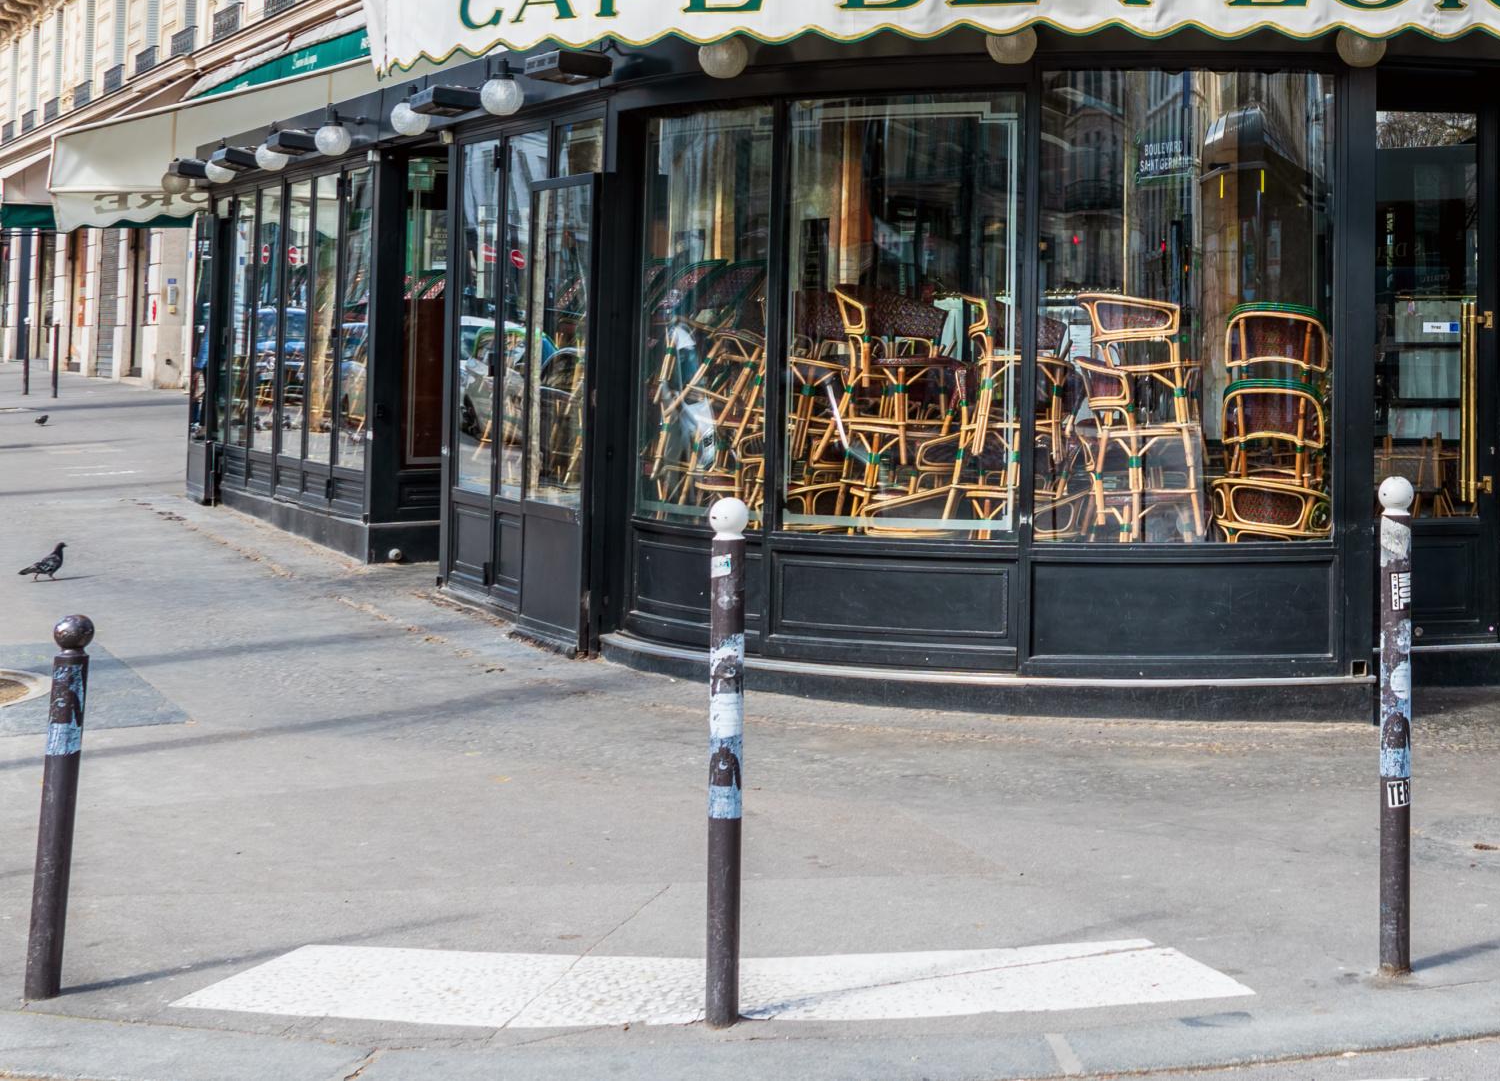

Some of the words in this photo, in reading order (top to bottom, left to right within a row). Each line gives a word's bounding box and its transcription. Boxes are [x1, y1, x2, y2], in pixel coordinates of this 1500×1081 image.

[1144, 140, 1183, 156] BOULEVARD
[1140, 158, 1158, 172] SAINT
[1160, 155, 1190, 170] GERMAIN
